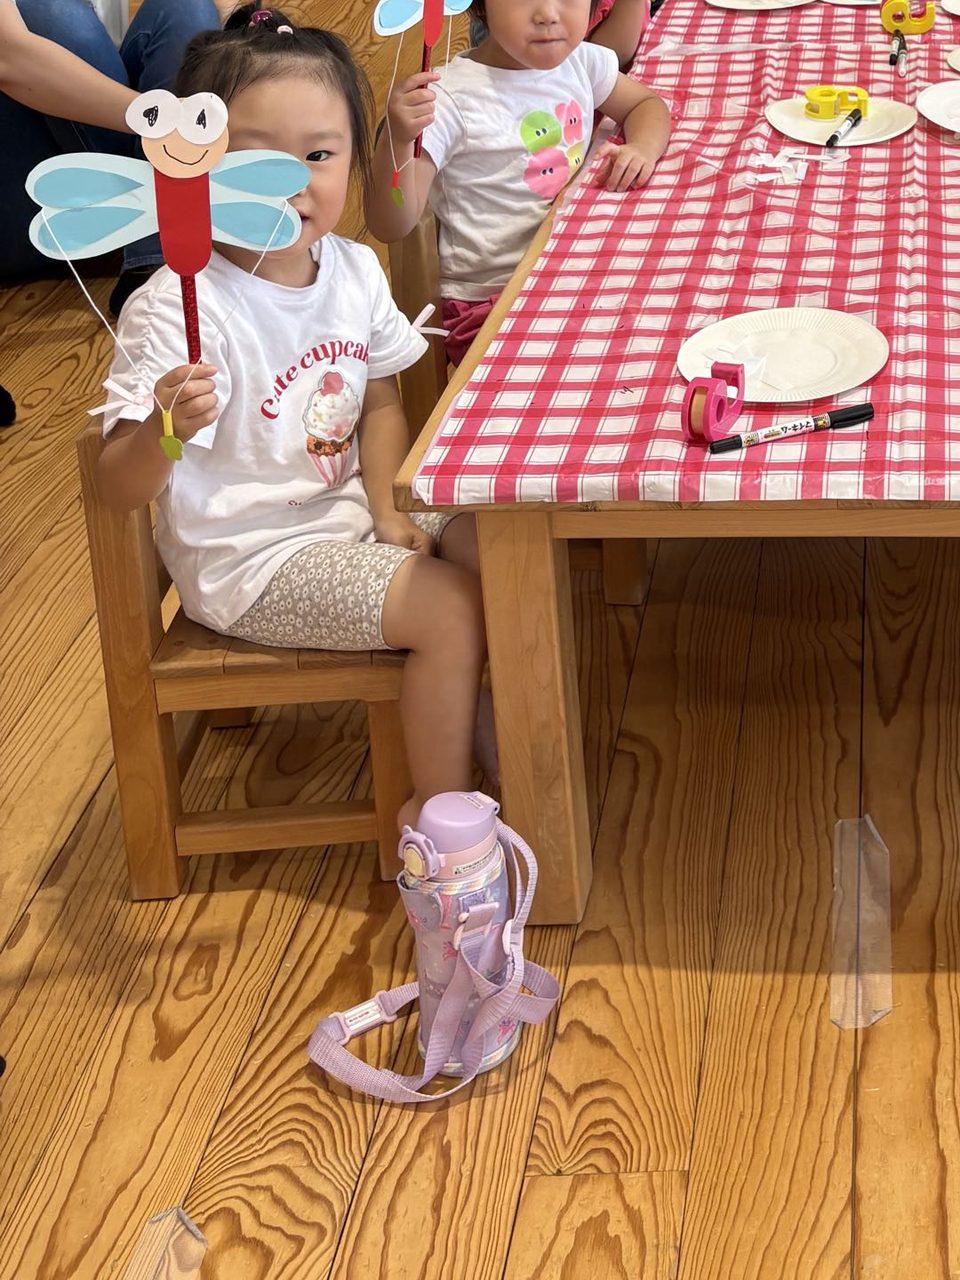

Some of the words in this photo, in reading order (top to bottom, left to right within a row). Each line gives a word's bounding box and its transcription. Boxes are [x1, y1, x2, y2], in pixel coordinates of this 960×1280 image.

[781, 421, 813, 434] マイネーム
